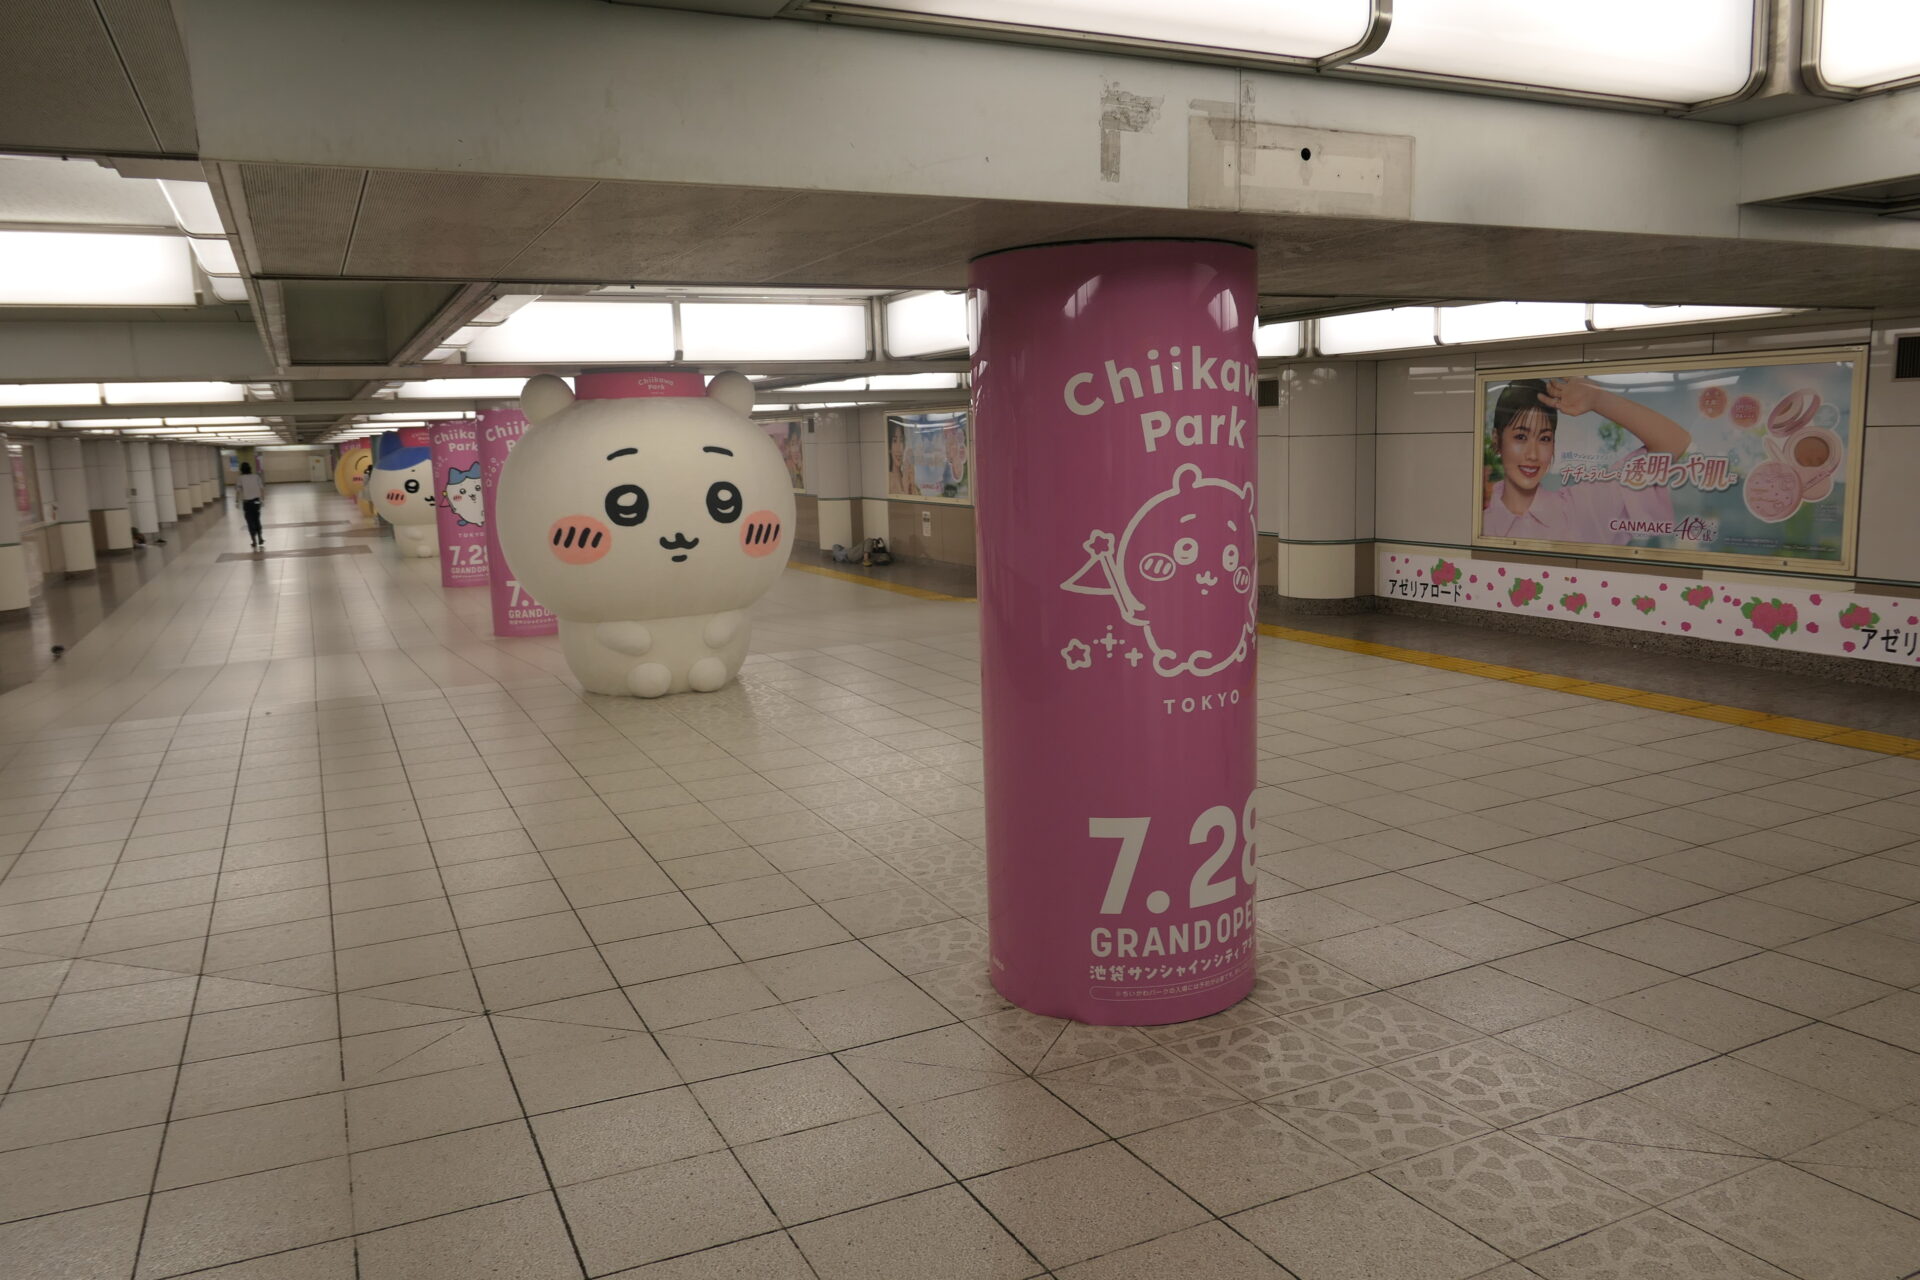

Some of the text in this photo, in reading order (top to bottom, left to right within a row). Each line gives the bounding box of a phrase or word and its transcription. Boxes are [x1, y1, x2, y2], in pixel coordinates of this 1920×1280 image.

[1140, 406, 1247, 453] Park
[448, 441, 479, 452] Park
[1610, 519, 1673, 534] CANMAKE
[1388, 579, 1462, 602] アゼリアロード
[1861, 628, 1918, 656] アゼリ
[1163, 689, 1240, 714] TOKYO
[1216, 895, 1256, 943] OPE
